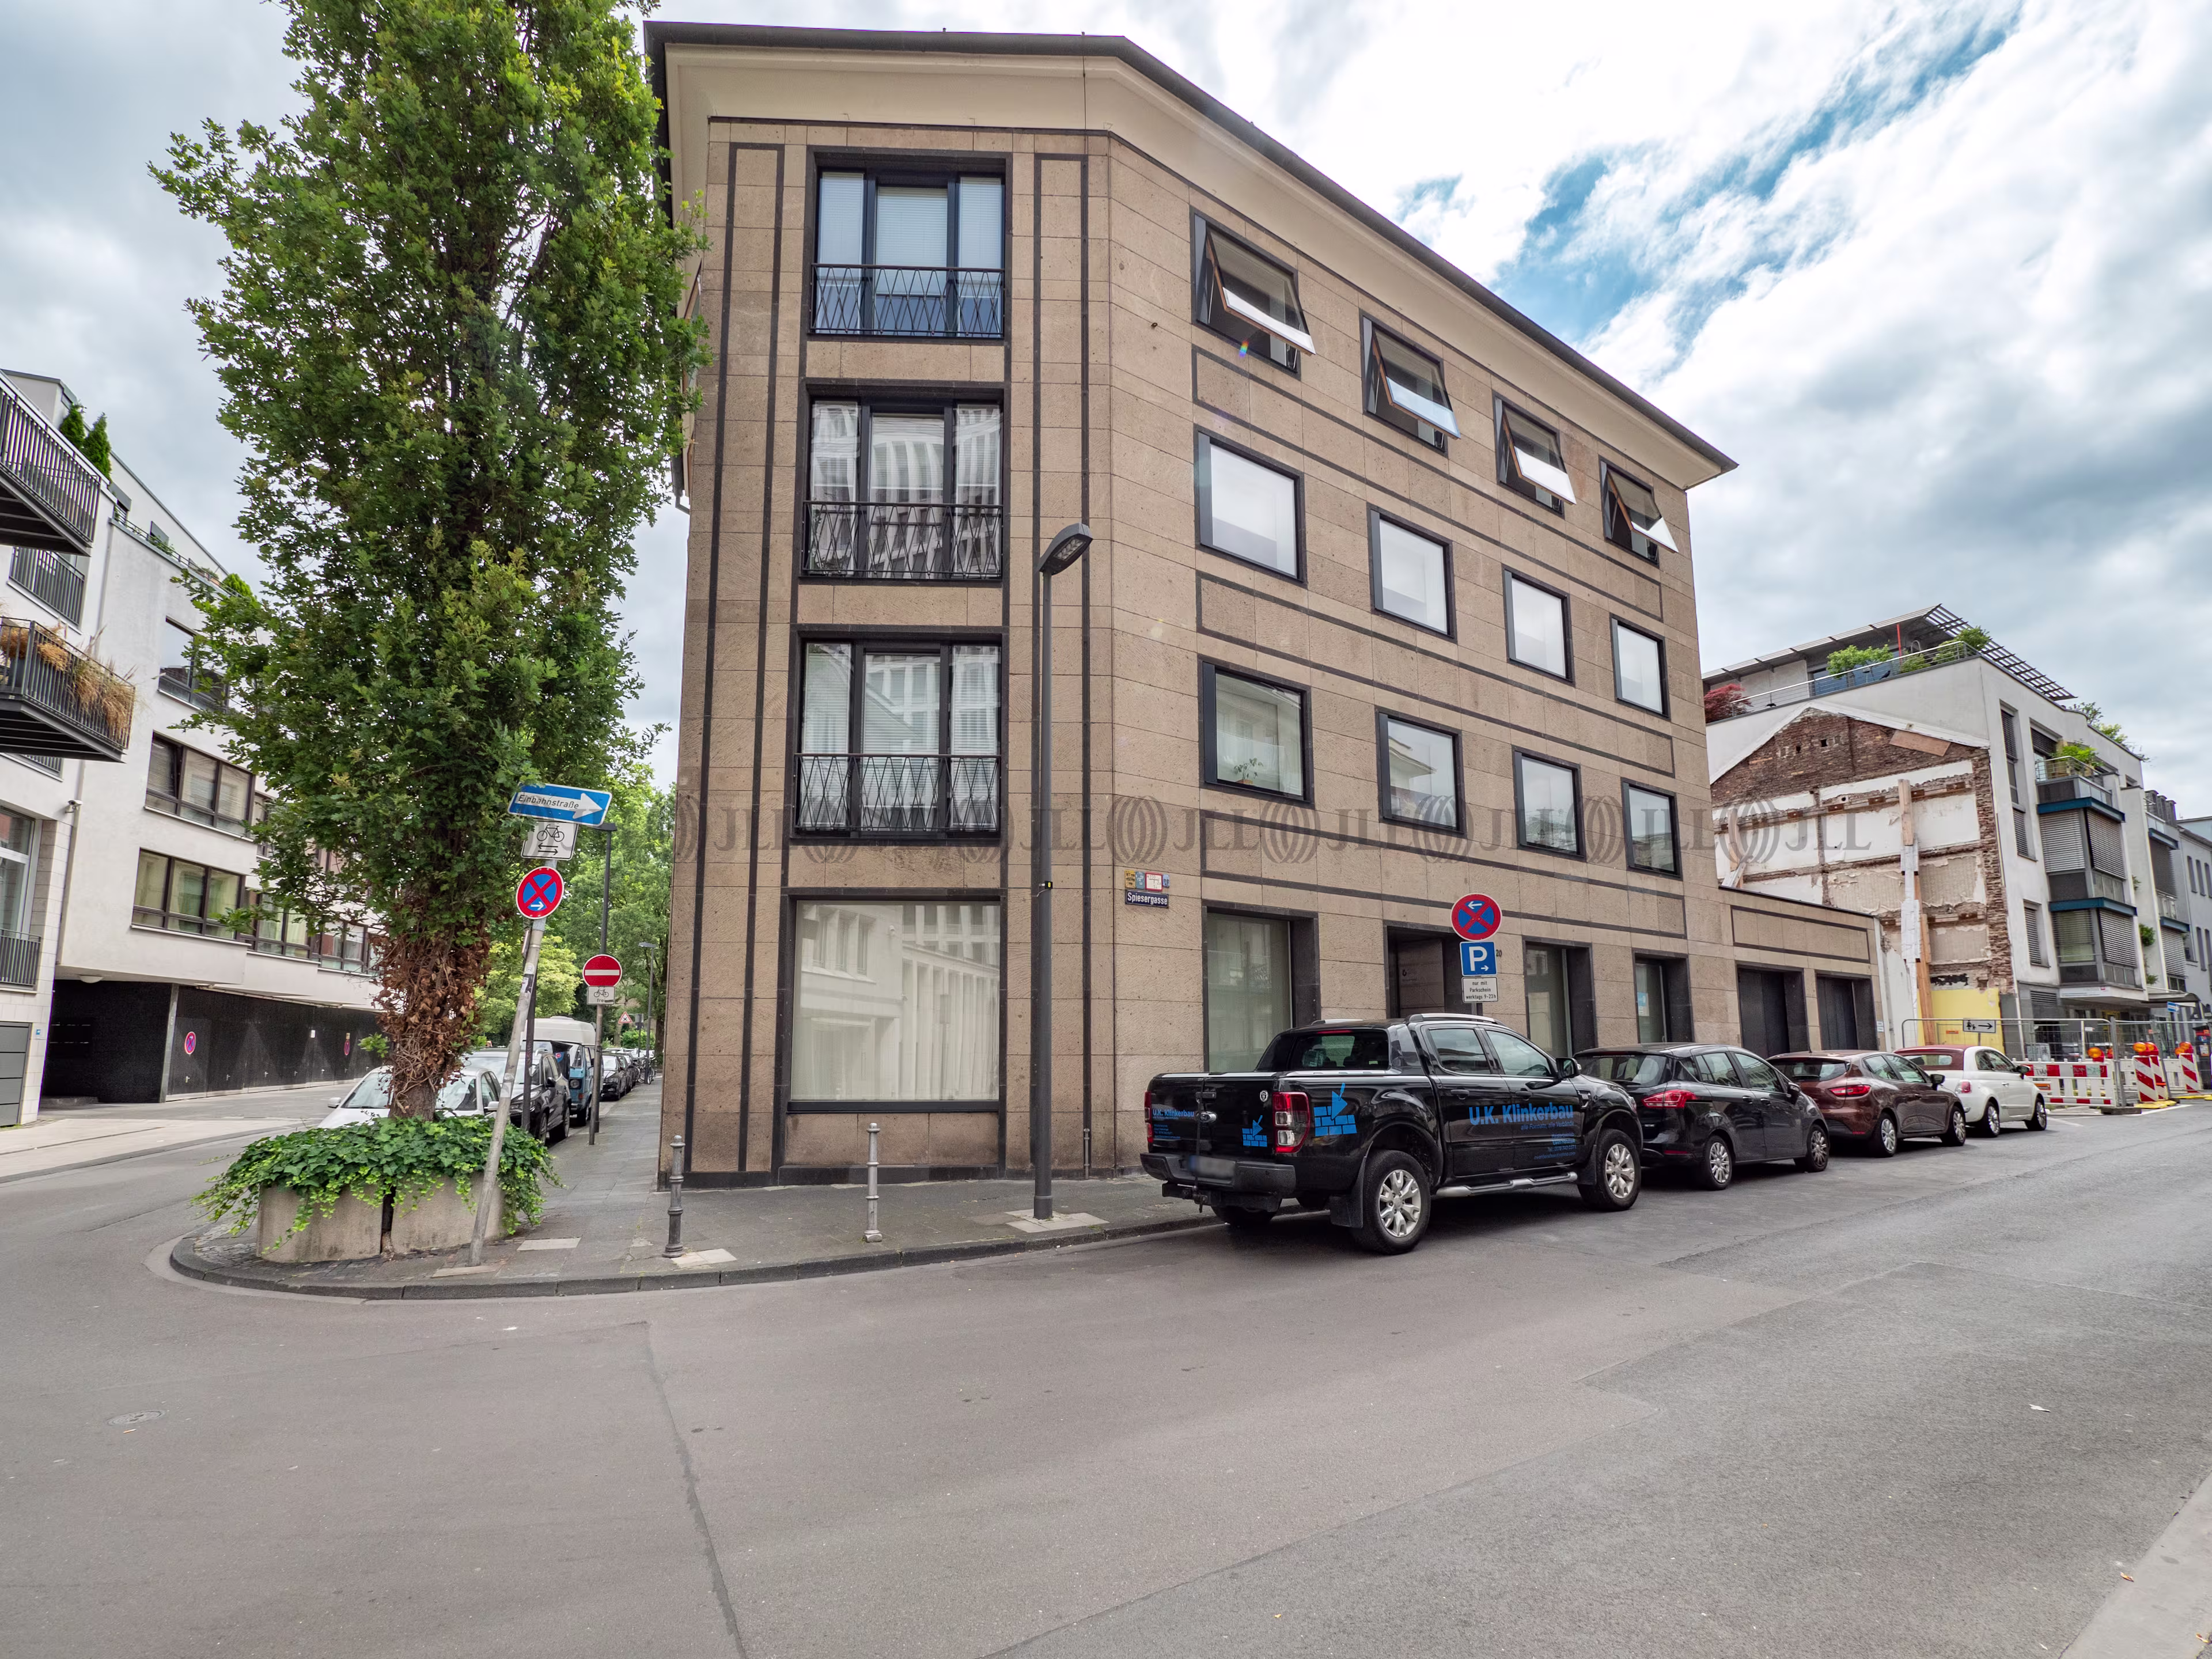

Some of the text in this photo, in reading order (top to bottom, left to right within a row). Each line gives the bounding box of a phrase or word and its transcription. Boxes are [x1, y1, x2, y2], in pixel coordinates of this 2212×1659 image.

[518, 794, 579, 809] Einbahnstraße
[1127, 892, 1168, 905] Spiesergasse
[1469, 946, 1488, 972] P
[1495, 949, 1502, 957] 20
[1468, 1102, 1574, 1126] U.K. Klinkerbau
